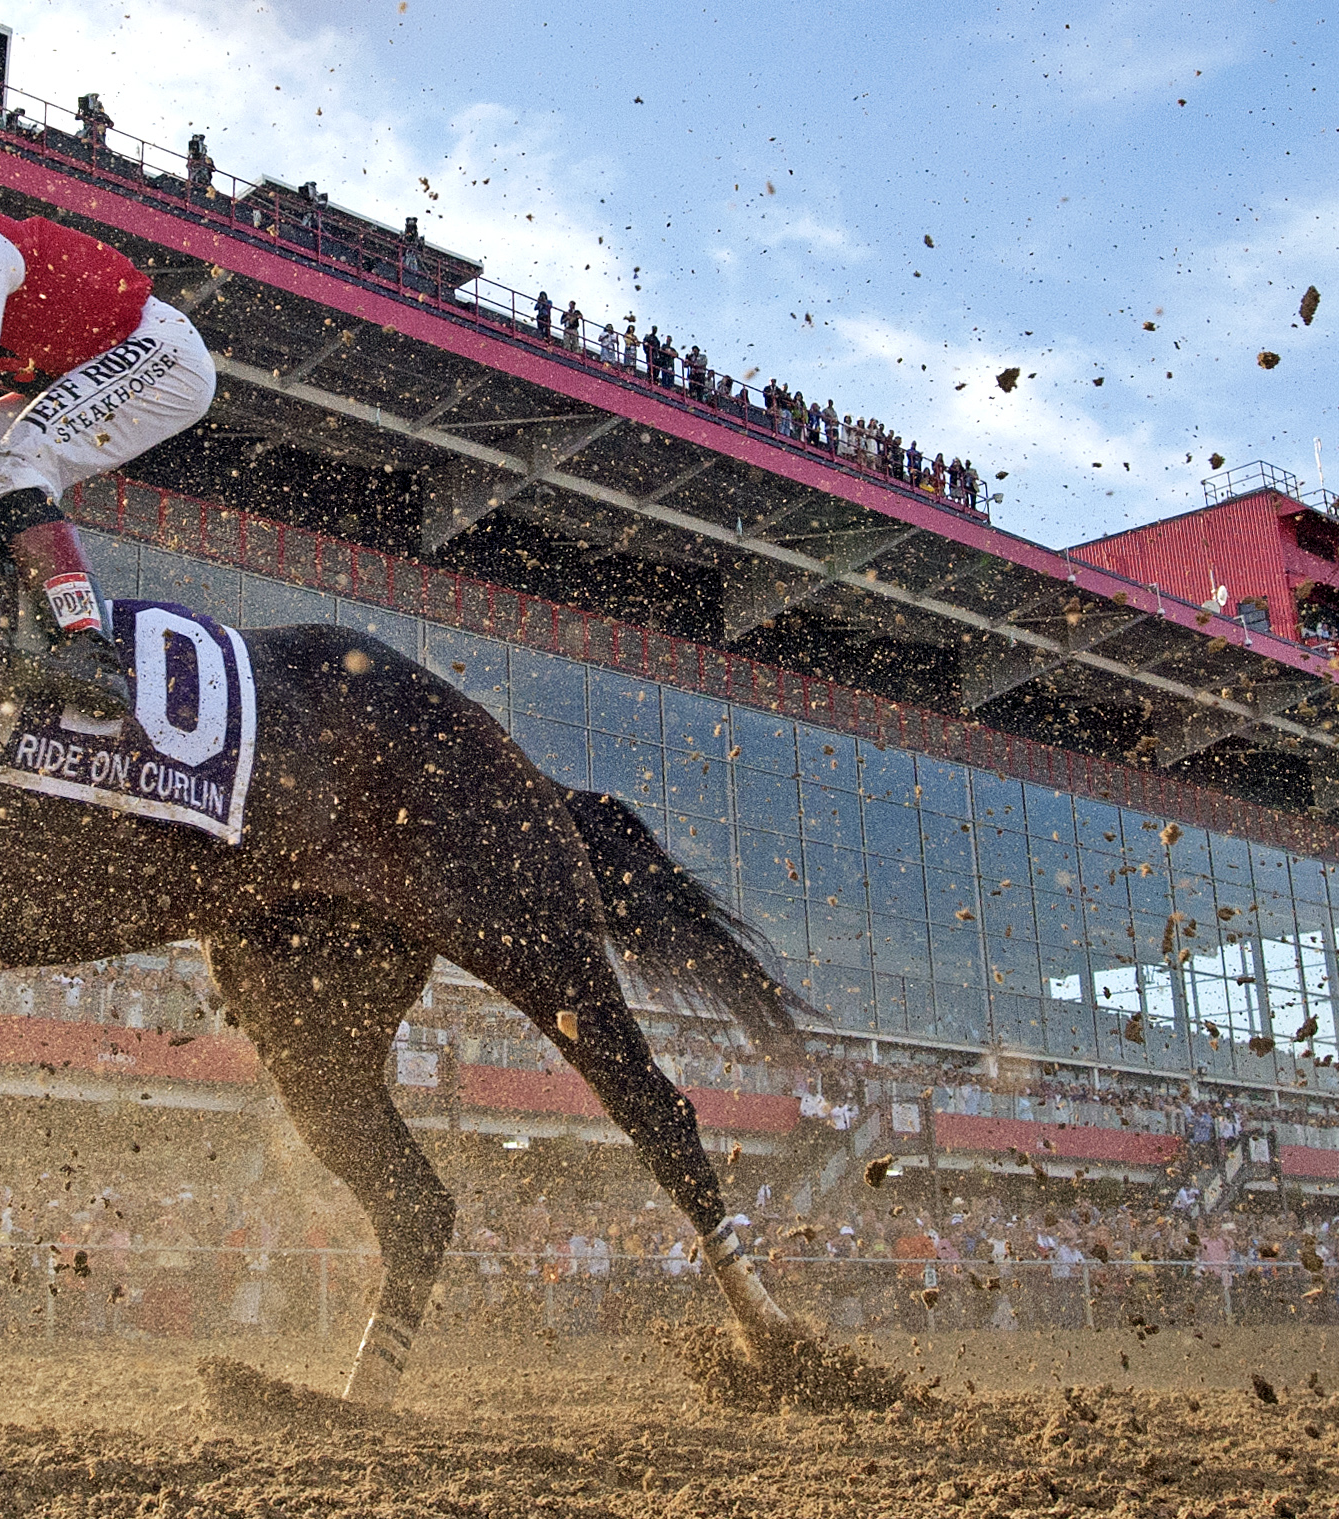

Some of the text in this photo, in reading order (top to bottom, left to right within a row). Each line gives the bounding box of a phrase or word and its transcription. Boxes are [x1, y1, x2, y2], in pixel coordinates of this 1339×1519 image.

[21, 378, 82, 434] JEFF
[57, 354, 176, 443] STEAKHOUSE
[15, 734, 225, 816] RIDE ON CURLIN
